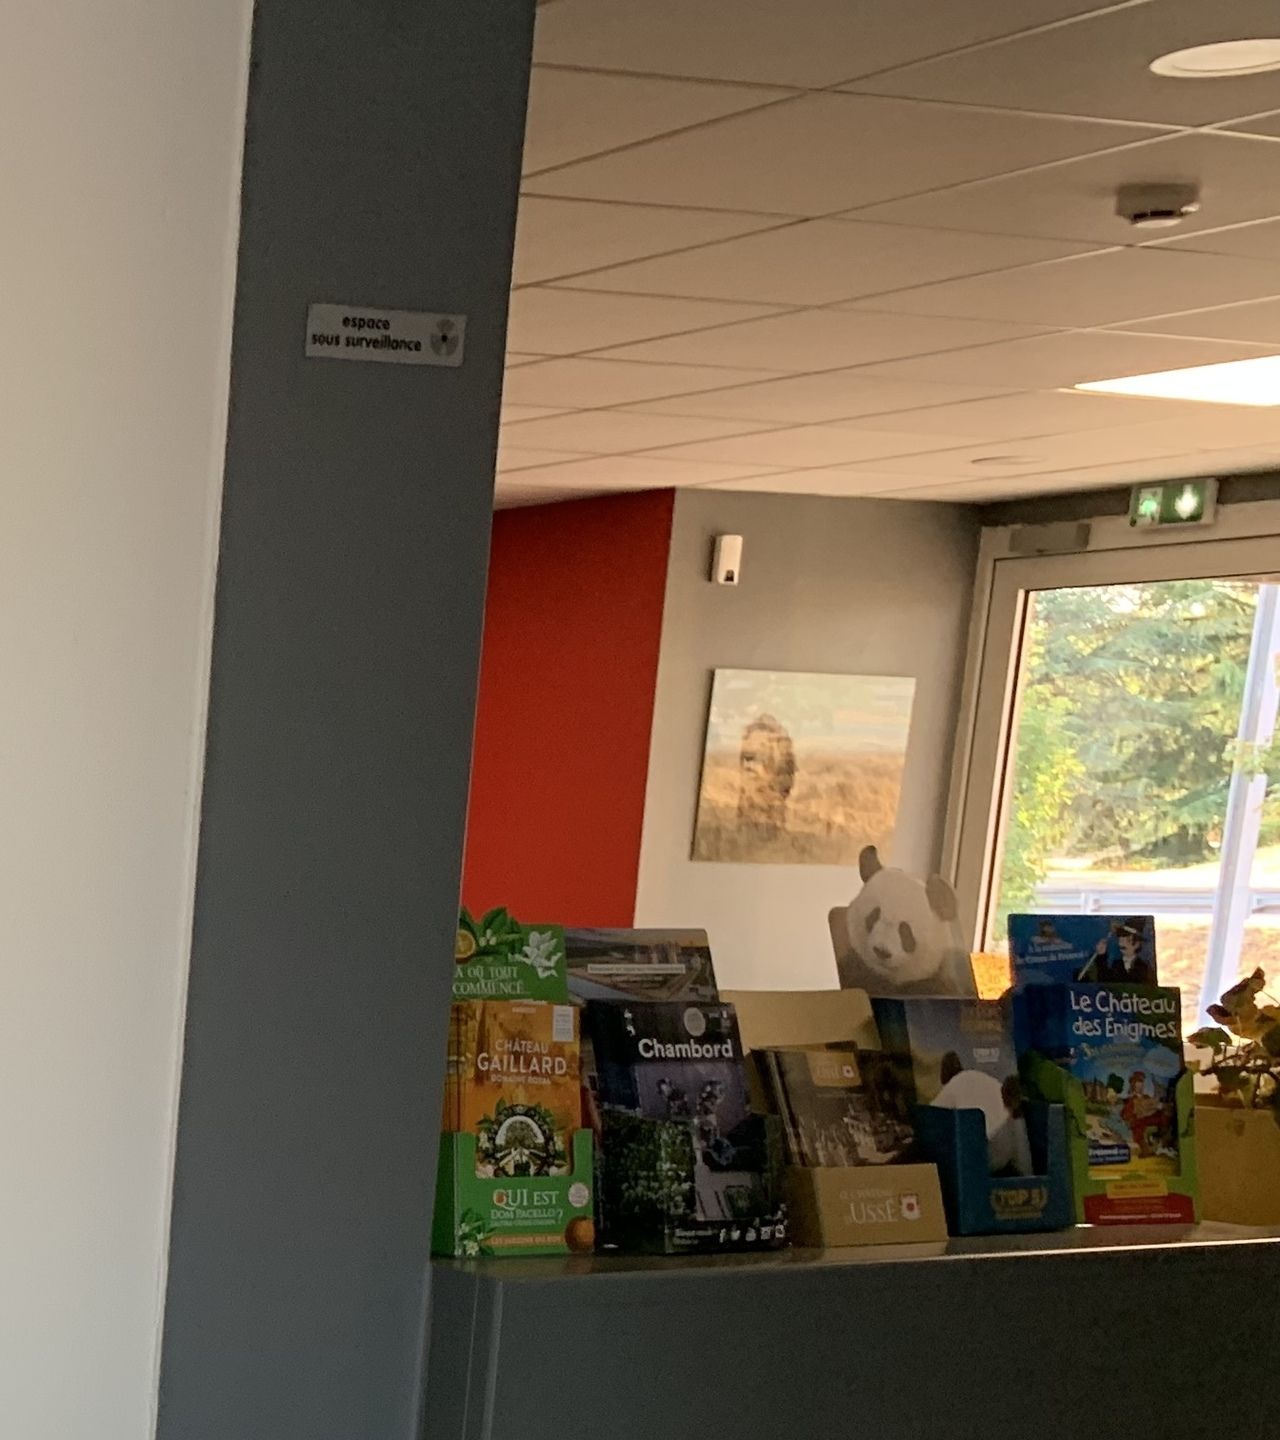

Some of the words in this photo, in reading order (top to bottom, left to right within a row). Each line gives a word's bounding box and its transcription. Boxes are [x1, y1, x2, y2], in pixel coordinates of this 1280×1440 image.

[342, 316, 390, 330] espace
[312, 333, 340, 346] sous
[345, 335, 421, 351] surveillance
[489, 966, 518, 979] TOUT
[1071, 991, 1092, 1012] Le
[1095, 991, 1176, 1014] Château
[1072, 1020, 1101, 1036] des
[1106, 1013, 1177, 1042] Énigmes
[495, 1038, 549, 1054] CHÂTEAU
[638, 1039, 733, 1059] Chambord
[477, 1052, 566, 1075] GAILLARD
[493, 1189, 529, 1208] QUI
[534, 1191, 559, 1205] EST
